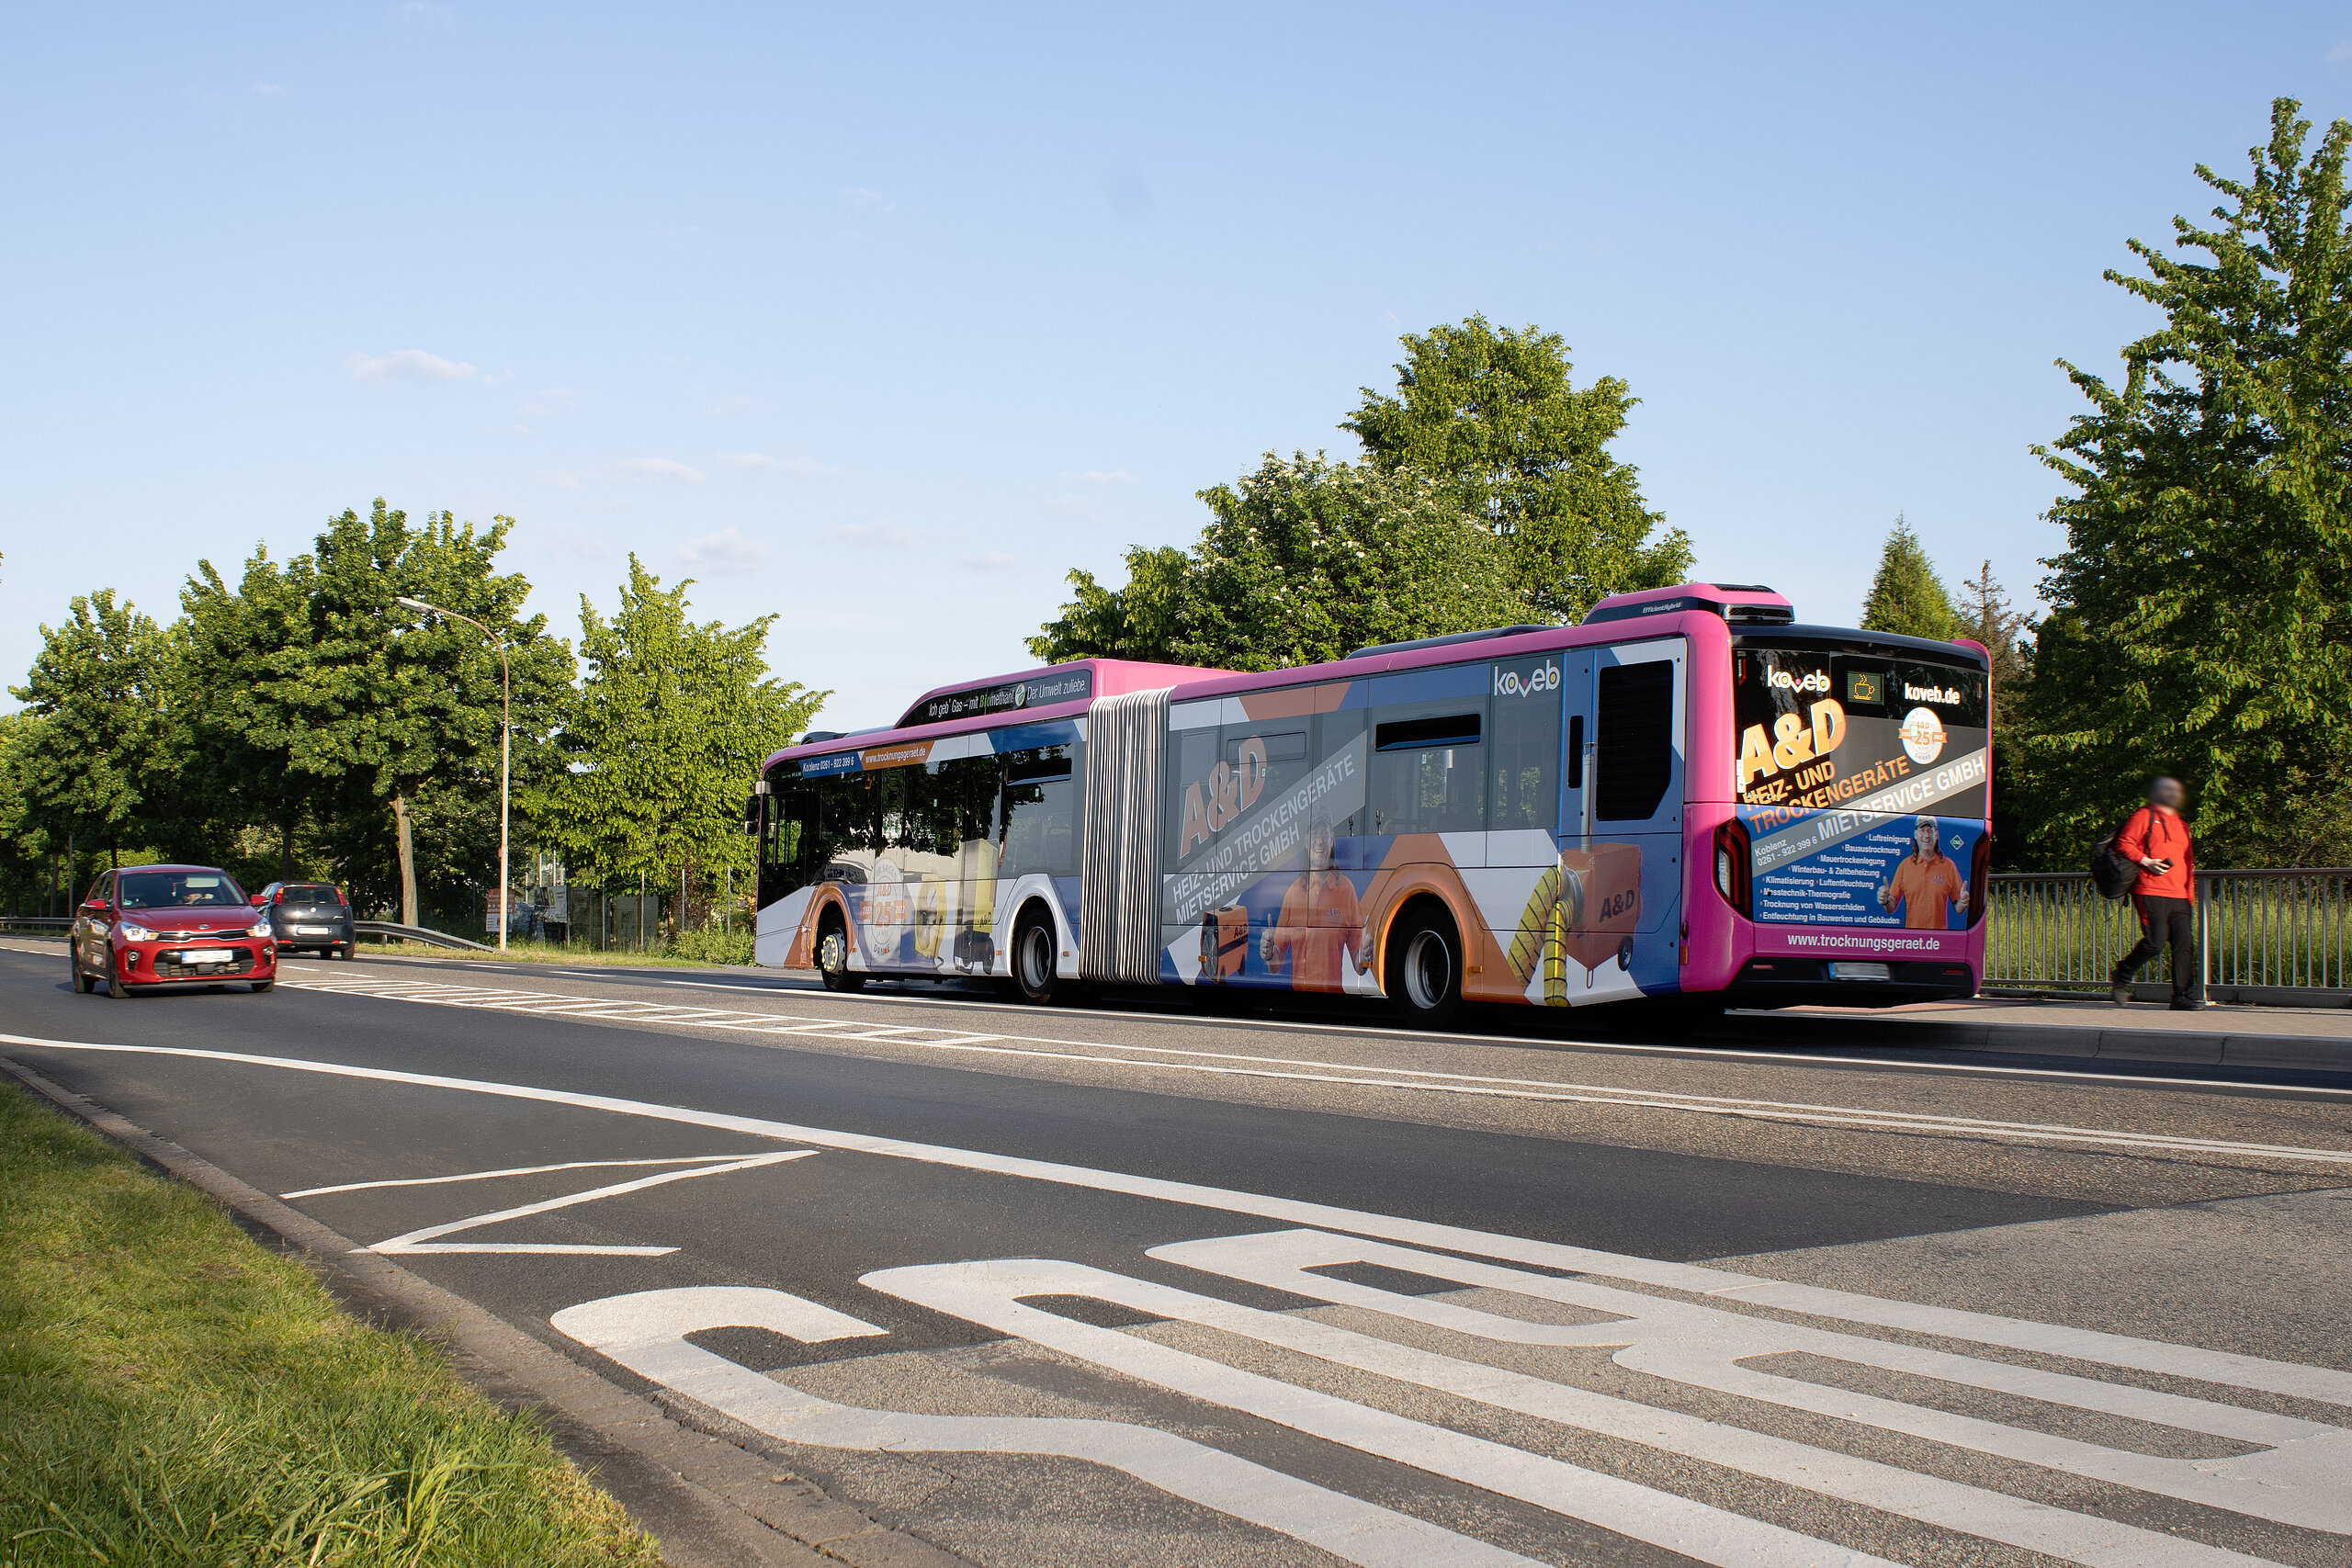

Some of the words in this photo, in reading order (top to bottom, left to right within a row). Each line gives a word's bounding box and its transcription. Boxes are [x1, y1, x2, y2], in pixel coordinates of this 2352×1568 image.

[1494, 659, 1560, 698] koveb
[1767, 665, 1831, 693] koveb
[1026, 686, 1038, 700] Der
[1039, 681, 1062, 699] Umwelt
[1063, 678, 1086, 694] zuliebe.
[1905, 682, 1961, 705] koveb.de
[929, 703, 937, 716] Ich
[952, 699, 962, 713] Gas
[968, 695, 978, 710] mit
[979, 690, 1014, 708] Biomethan!
[1740, 698, 1846, 785] A&D
[1915, 731, 1929, 745] 25
[865, 747, 926, 764] www.trocknungsgeraet.de
[802, 761, 820, 773] Koblenz
[833, 759, 842, 768] 922
[842, 758, 850, 767] 399
[851, 757, 854, 765] 6
[1742, 779, 1792, 811] HEIZ-
[1795, 761, 1836, 791] UND
[1748, 755, 1910, 833] TROCKENGERÄTE
[1180, 735, 1267, 859] A&D
[1816, 777, 1932, 840] MIETSERVICE
[1936, 756, 1986, 791] GMBH
[1172, 871, 1205, 904] HEIZ-
[1206, 845, 1233, 876] UND
[1235, 754, 1355, 857] TROCKENGERÄTE
[1754, 839, 1787, 857] Koblenz
[1868, 833, 1911, 845] Luftreinigung
[1757, 852, 1776, 866] 0261
[1781, 846, 1796, 857] 922
[1797, 840, 1811, 851] 399
[1811, 836, 1817, 844] 6
[1845, 844, 1901, 856] Bauaustrocknung
[1820, 854, 1885, 866] Mauertrockenlegung
[1176, 852, 1258, 925] MIETSERVICE
[1260, 823, 1300, 865] GMBH
[1792, 865, 1827, 874] Winterbau-
[1765, 875, 1815, 887] Klimatisierung
[1819, 878, 1874, 889] Luftentfeuchtung
[876, 884, 891, 897] A&D
[1599, 889, 1634, 923] A&D
[1763, 899, 1799, 910] Trocknung
[1815, 901, 1865, 911] Wasserschäden
[875, 901, 892, 928] 25
[979, 912, 992, 928] A&D
[1763, 912, 1808, 922] Entfeuchtung
[1817, 914, 1853, 922] Bauwerken
[1854, 915, 1867, 923] und
[1868, 915, 1900, 924] Gebäuden
[1233, 923, 1247, 939] A&D
[873, 943, 890, 955] DANE
[1787, 933, 1940, 952] www.trocknungsgeraet.de
